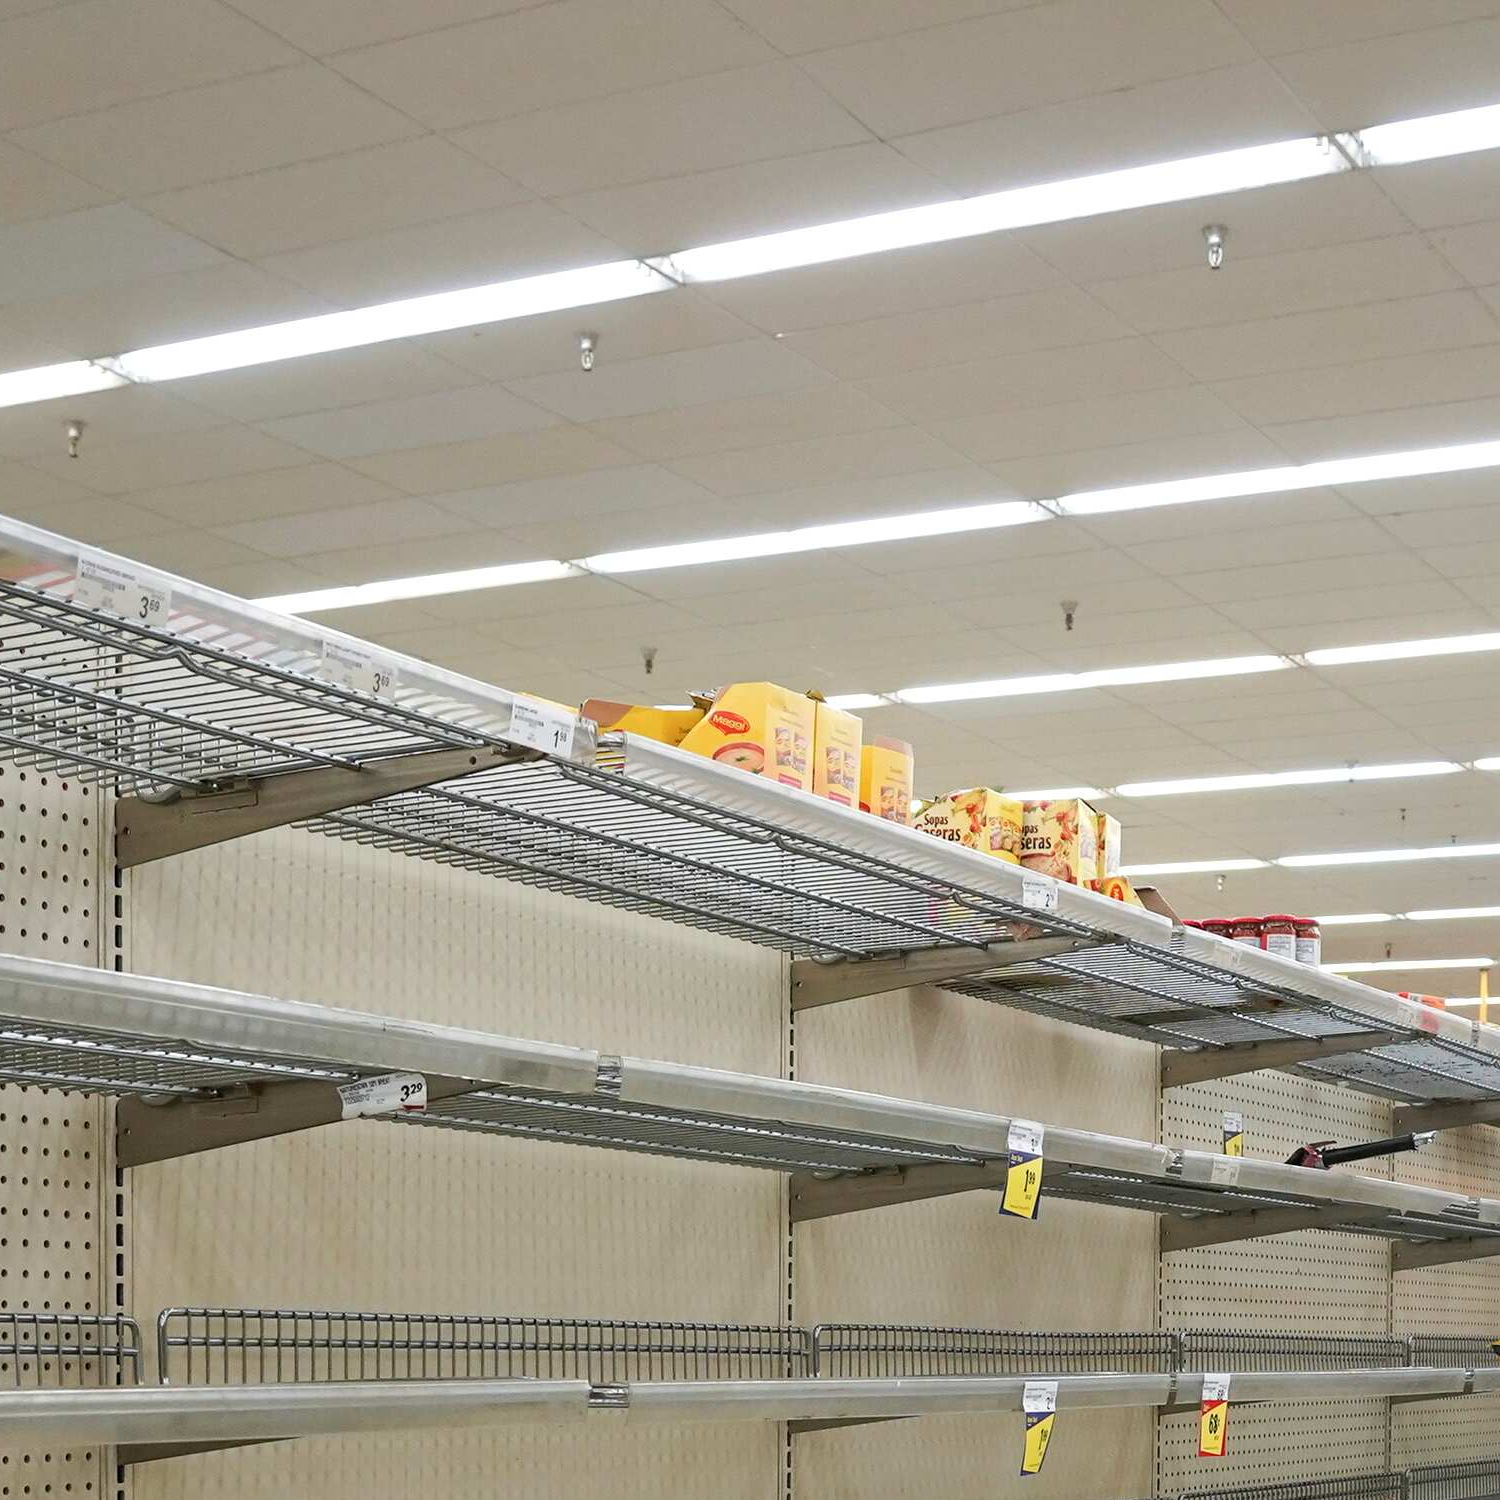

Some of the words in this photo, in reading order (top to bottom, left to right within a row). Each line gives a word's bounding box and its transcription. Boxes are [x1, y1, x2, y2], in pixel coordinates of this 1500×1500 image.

[711, 713, 747, 731] Maggi
[924, 813, 949, 829] Sopas
[1021, 825, 1038, 839] pas
[1020, 835, 1051, 850] seras
[400, 1082, 423, 1103] 329
